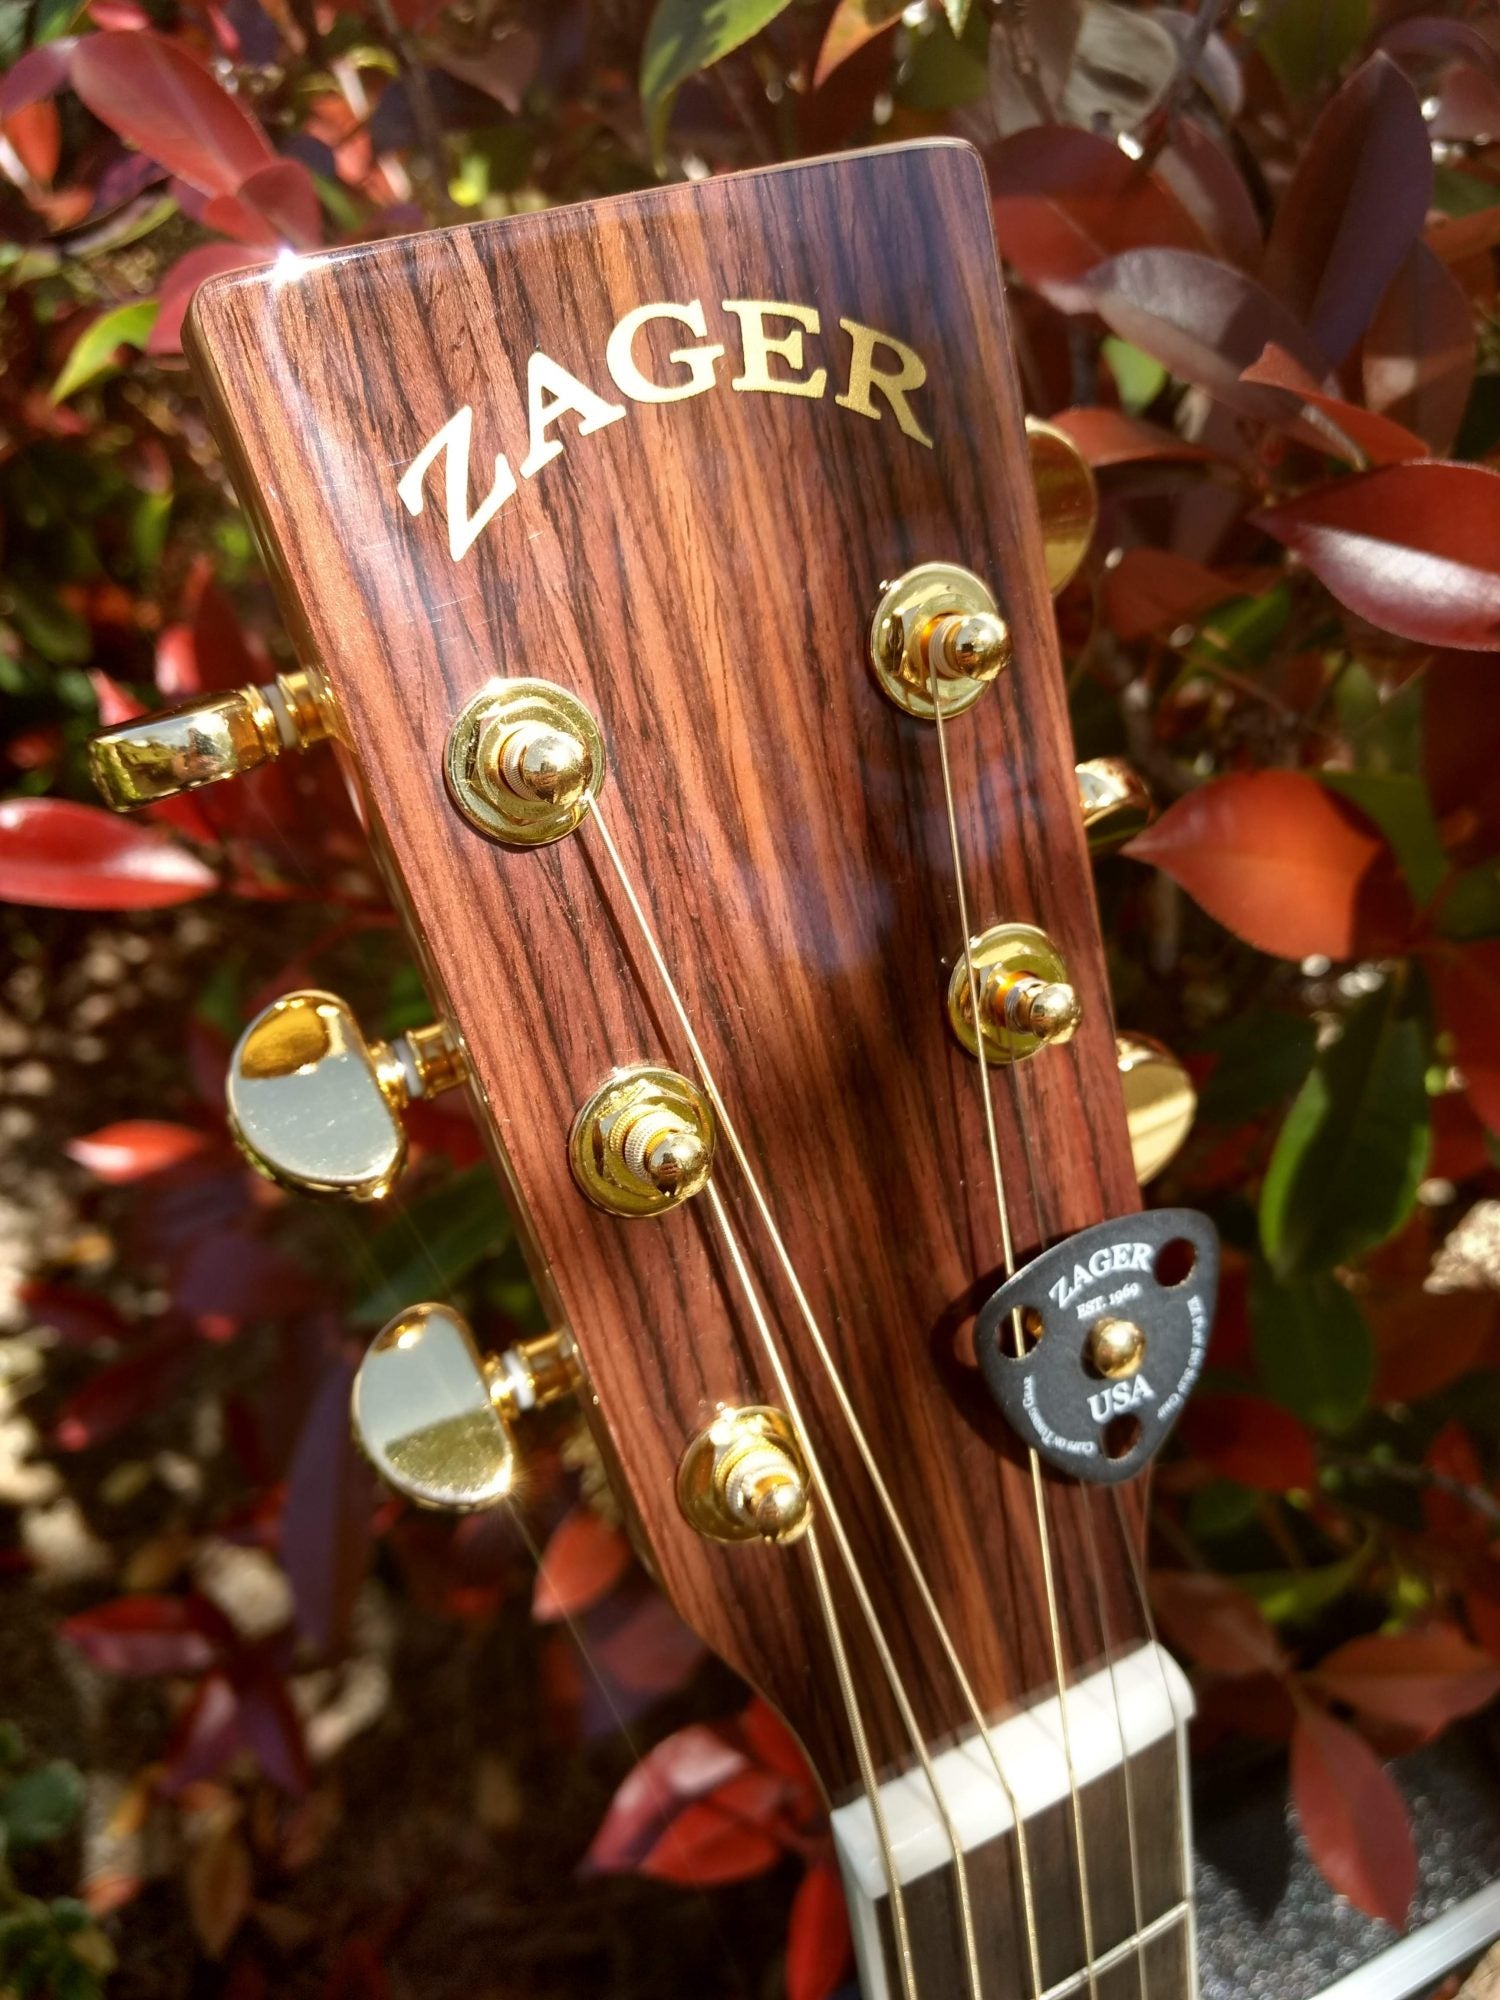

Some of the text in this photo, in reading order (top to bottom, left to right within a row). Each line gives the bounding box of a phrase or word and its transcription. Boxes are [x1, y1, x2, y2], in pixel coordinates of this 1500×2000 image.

[397, 299, 934, 563] ZAGER
[1048, 1243, 1155, 1309] ZAGER
[1076, 1282, 1141, 1319] EST. 1969
[1087, 1374, 1156, 1424] USA
